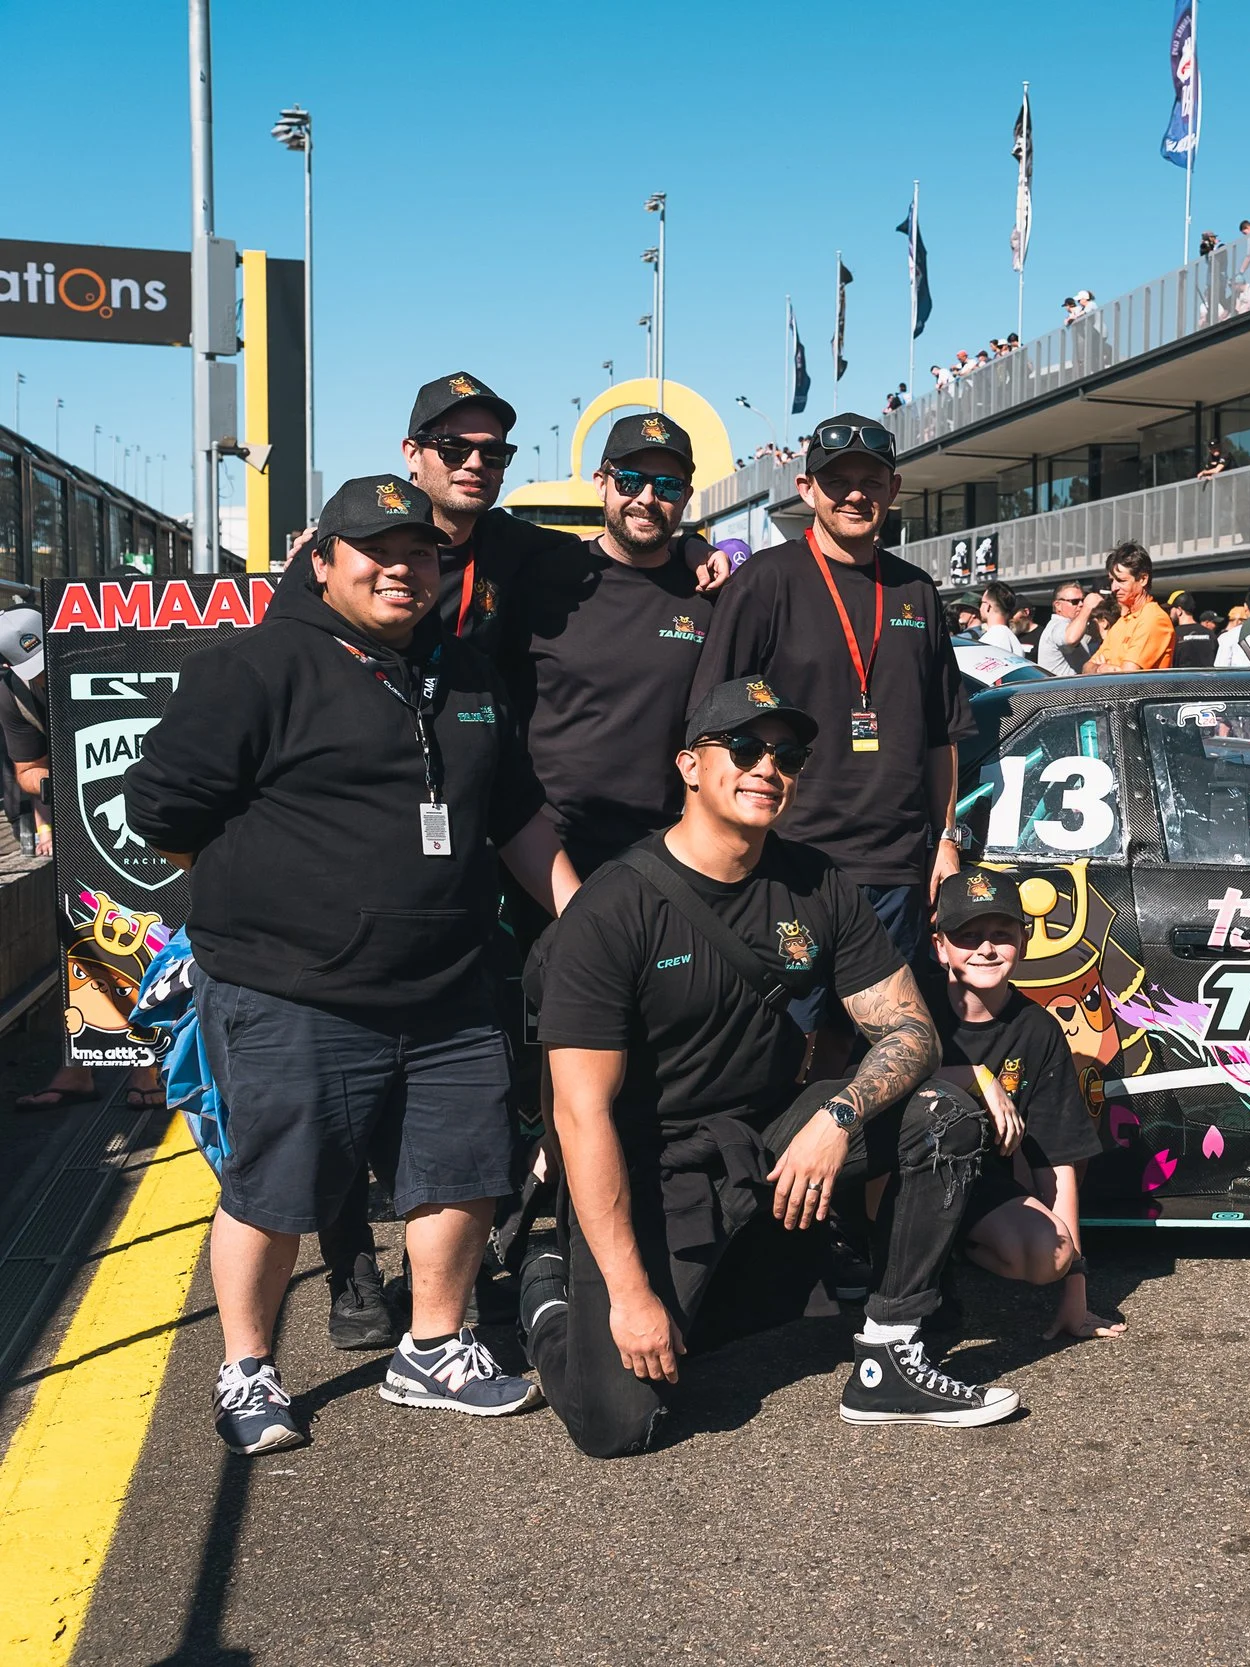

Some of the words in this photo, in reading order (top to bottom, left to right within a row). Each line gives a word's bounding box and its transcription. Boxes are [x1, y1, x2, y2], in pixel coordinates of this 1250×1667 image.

[890, 618, 926, 629] TANUKI
[658, 629, 705, 643] TANUKI
[980, 756, 1114, 850] 13
[123, 857, 167, 865] RACIN
[656, 953, 692, 970] CREW
